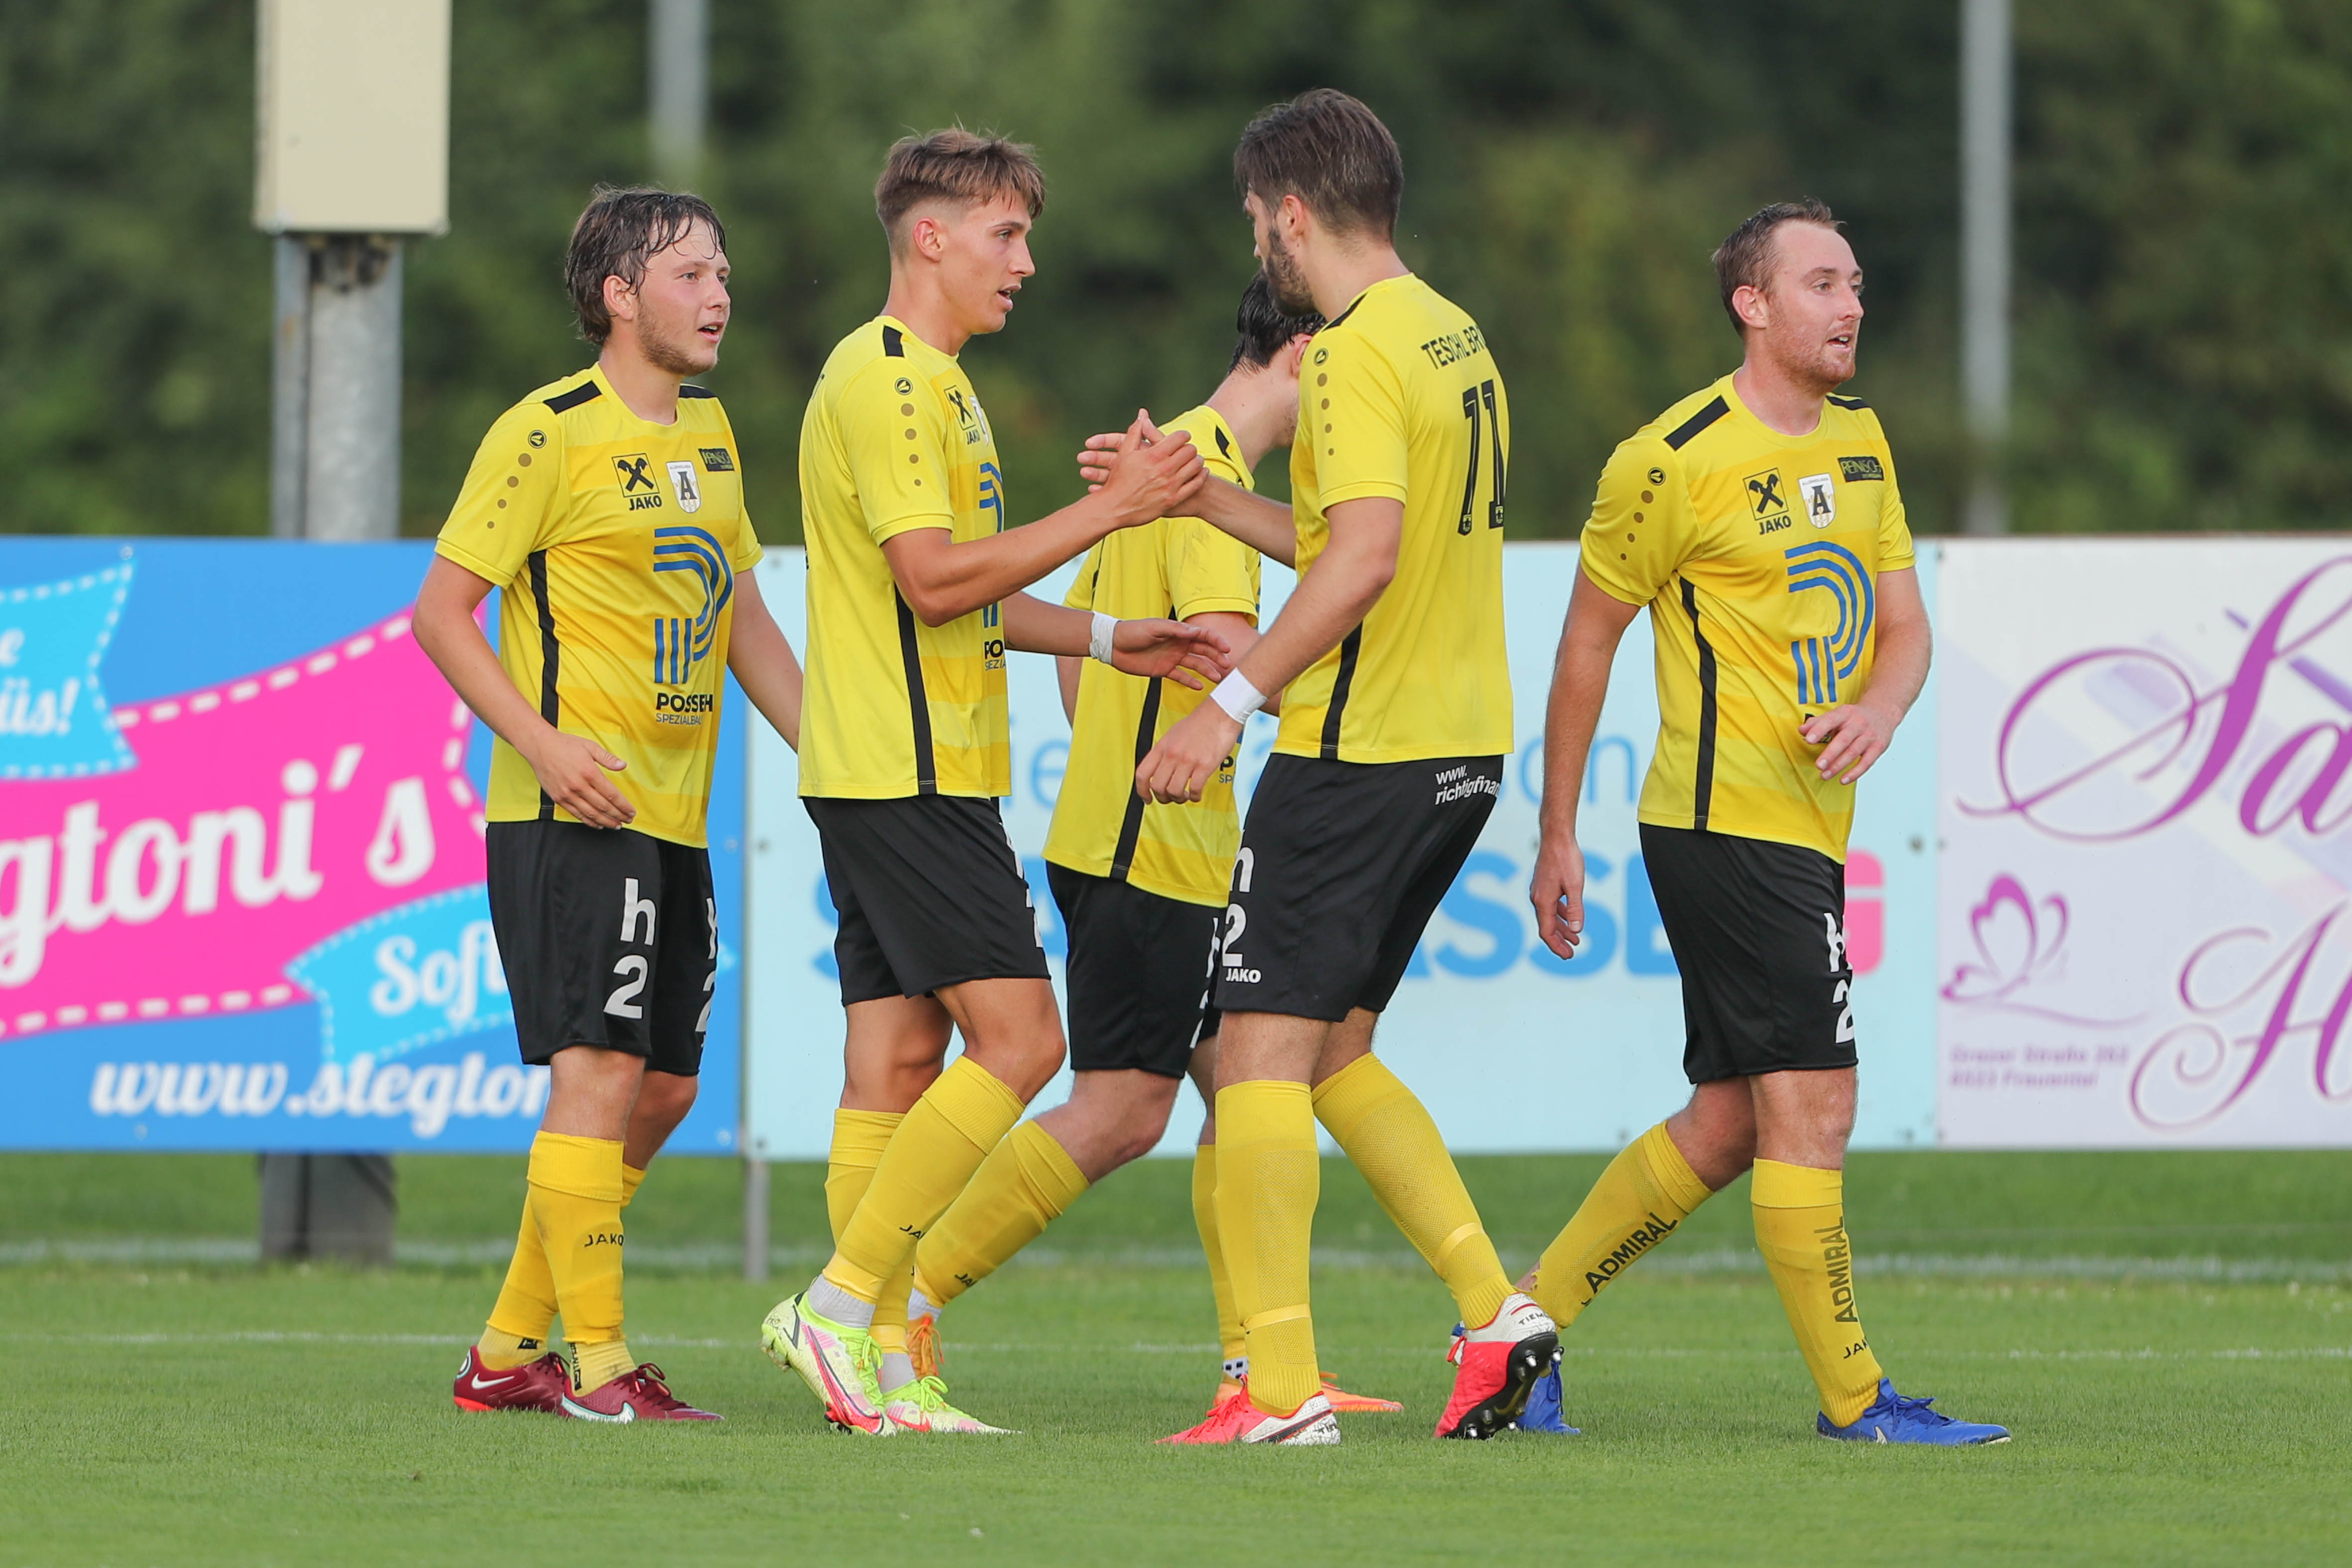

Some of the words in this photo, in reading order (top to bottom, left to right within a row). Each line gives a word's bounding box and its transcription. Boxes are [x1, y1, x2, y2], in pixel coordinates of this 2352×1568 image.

[1421, 333, 1470, 369] TESCHL
[1463, 325, 1487, 354] BR
[629, 495, 662, 511] JAKO
[1759, 515, 1792, 535] JAKO
[1435, 765, 1467, 785] www.
[1226, 968, 1262, 983] JAKO
[603, 955, 648, 1019] 2
[584, 1233, 624, 1247] JAKO
[1585, 1211, 1678, 1294] ADMIRAL
[1814, 1216, 1859, 1323] ADMIRAL
[1519, 1313, 1546, 1325] TIEM
